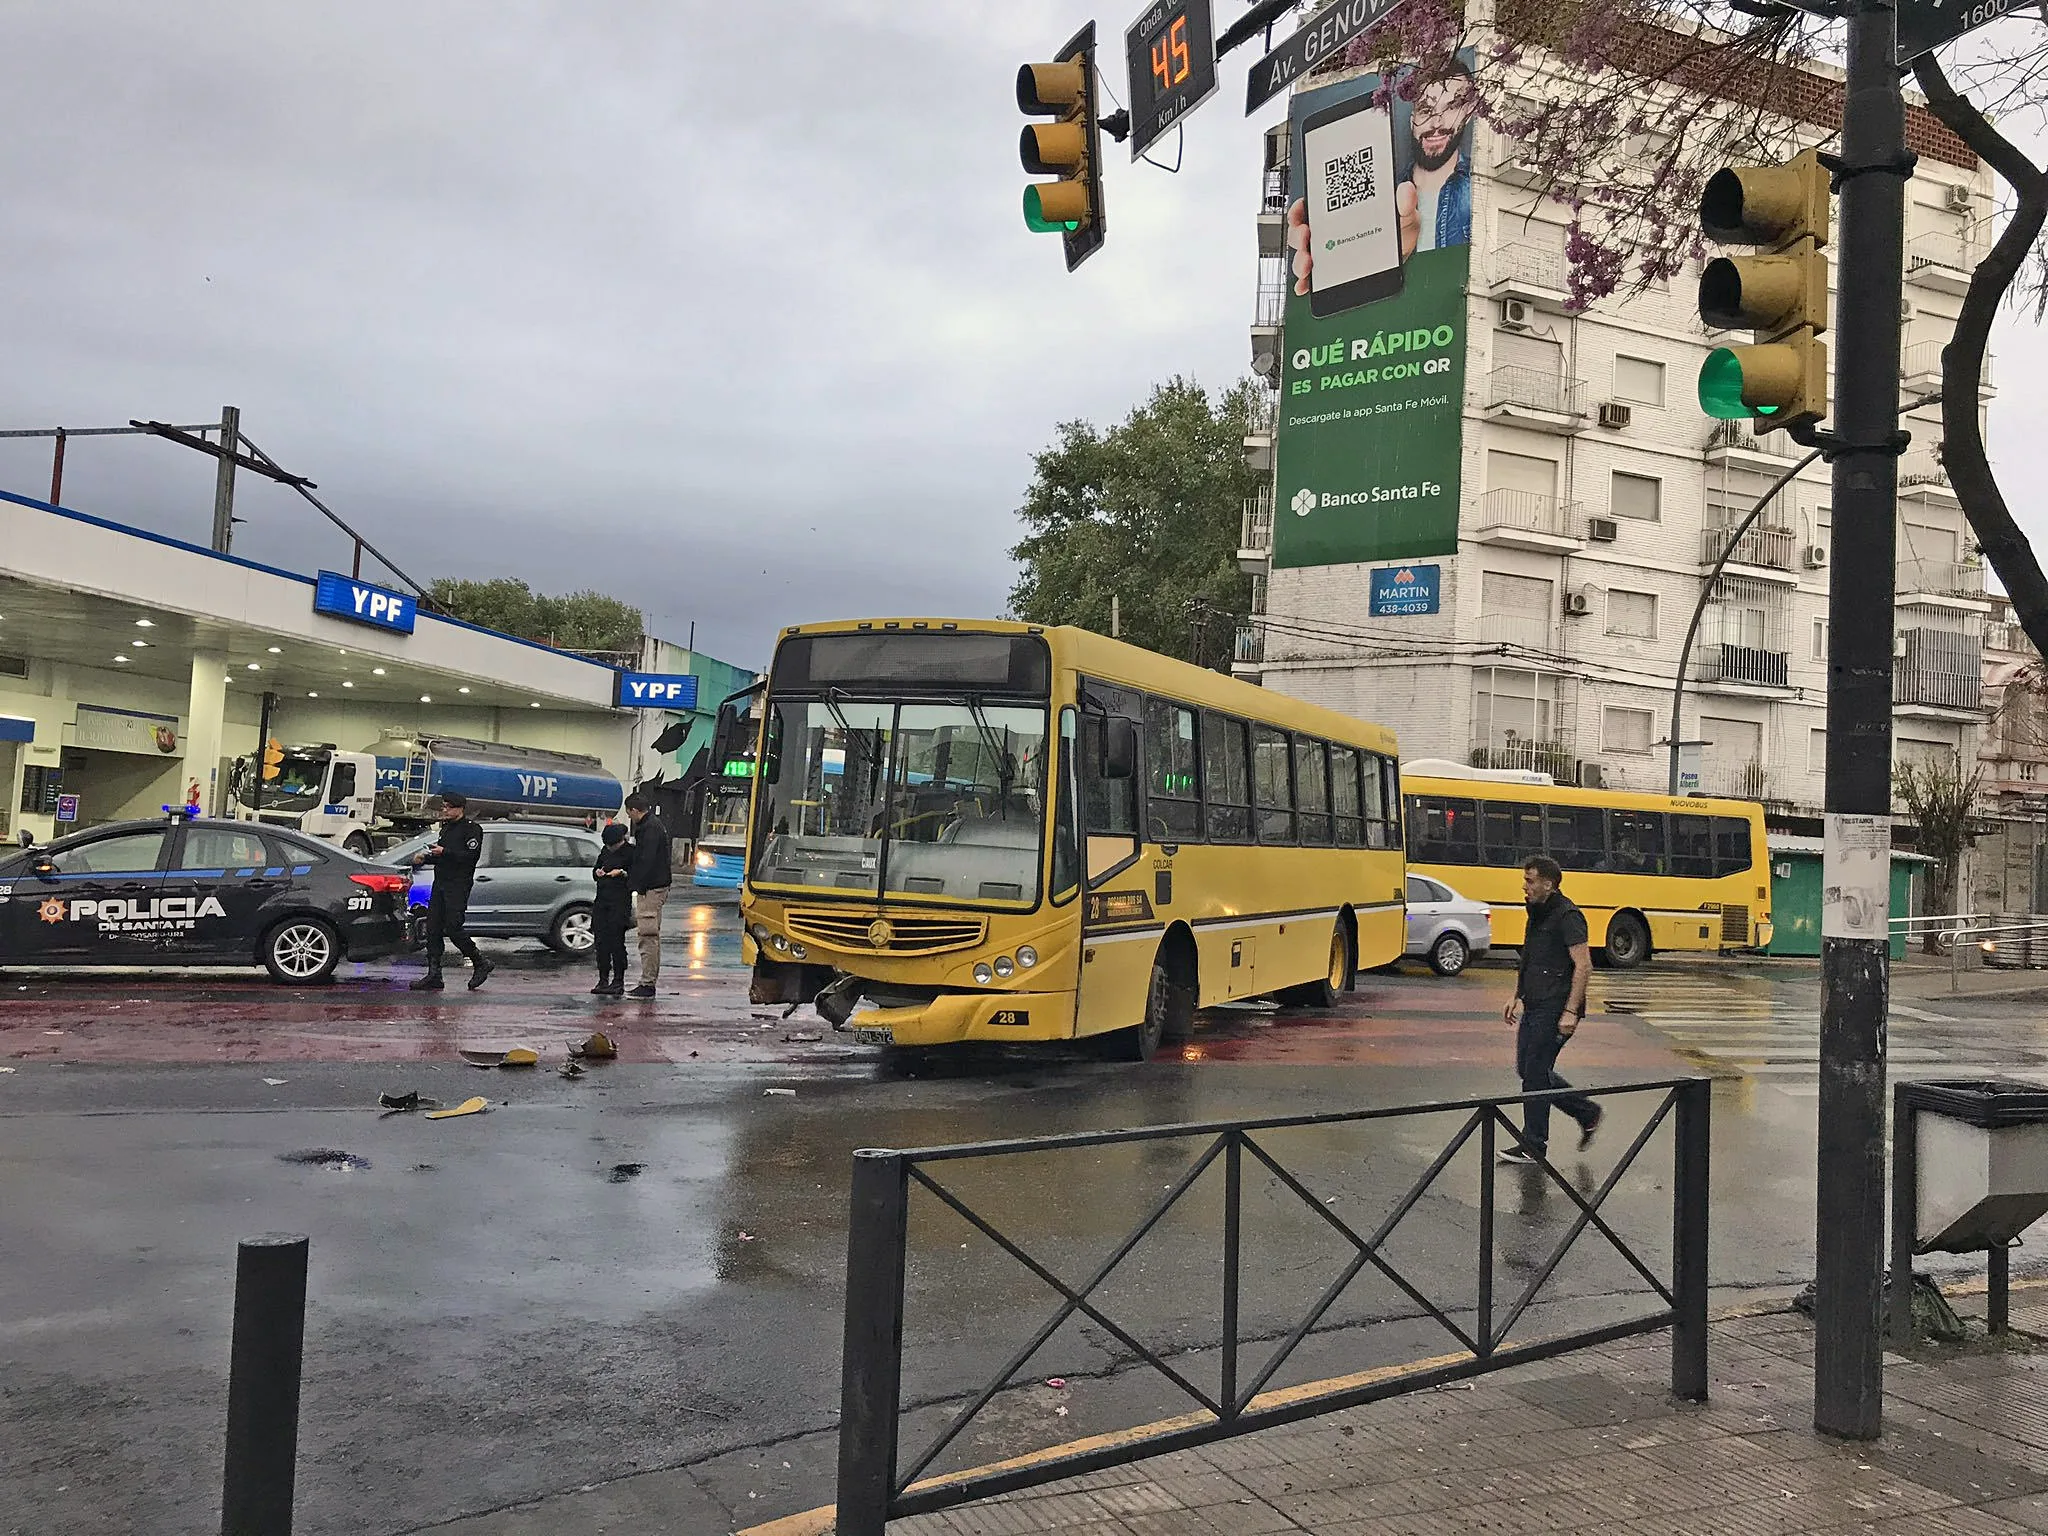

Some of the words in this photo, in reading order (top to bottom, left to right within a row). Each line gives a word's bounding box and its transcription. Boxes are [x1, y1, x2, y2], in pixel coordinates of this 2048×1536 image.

[1140, 8, 1162, 37] Onda
[1960, 0, 2008, 29] 1600
[1152, 15, 1190, 89] 45
[1268, 56, 1296, 91] Av.
[1304, 0, 1386, 62] GENOV
[1337, 236, 1356, 246] Banco
[1356, 230, 1374, 240] Santa
[1374, 226, 1383, 234] Fe
[1292, 338, 1345, 370] QUÉ
[1351, 325, 1454, 361] RÁPIDO
[1291, 379, 1312, 395] ES
[1320, 369, 1379, 391] PAGAR
[1381, 361, 1420, 381] CON
[1423, 357, 1451, 375] QR
[1289, 411, 1342, 426] Descargate
[1343, 408, 1352, 419] la
[1353, 407, 1373, 418] app
[1375, 402, 1403, 414] Santa
[1405, 400, 1418, 410] Fe
[1420, 395, 1450, 408] Móvil.
[1321, 492, 1369, 508] Banco
[1371, 485, 1418, 503] Santa
[1421, 481, 1441, 497] Fe
[352, 586, 403, 622] YPF
[1379, 586, 1429, 600] MARTIN
[1379, 603, 1428, 614] 438-4039
[630, 682, 682, 700] YPF
[517, 773, 559, 798] YPF
[1670, 799, 1708, 809] NUOVOBUS
[70, 897, 227, 921] POLICIA
[347, 897, 373, 910] 911
[1090, 896, 1100, 919] 28
[98, 922, 120, 931] DE
[122, 920, 174, 930] SANTA
[176, 920, 195, 929] FE
[999, 1012, 1015, 1024] 28
